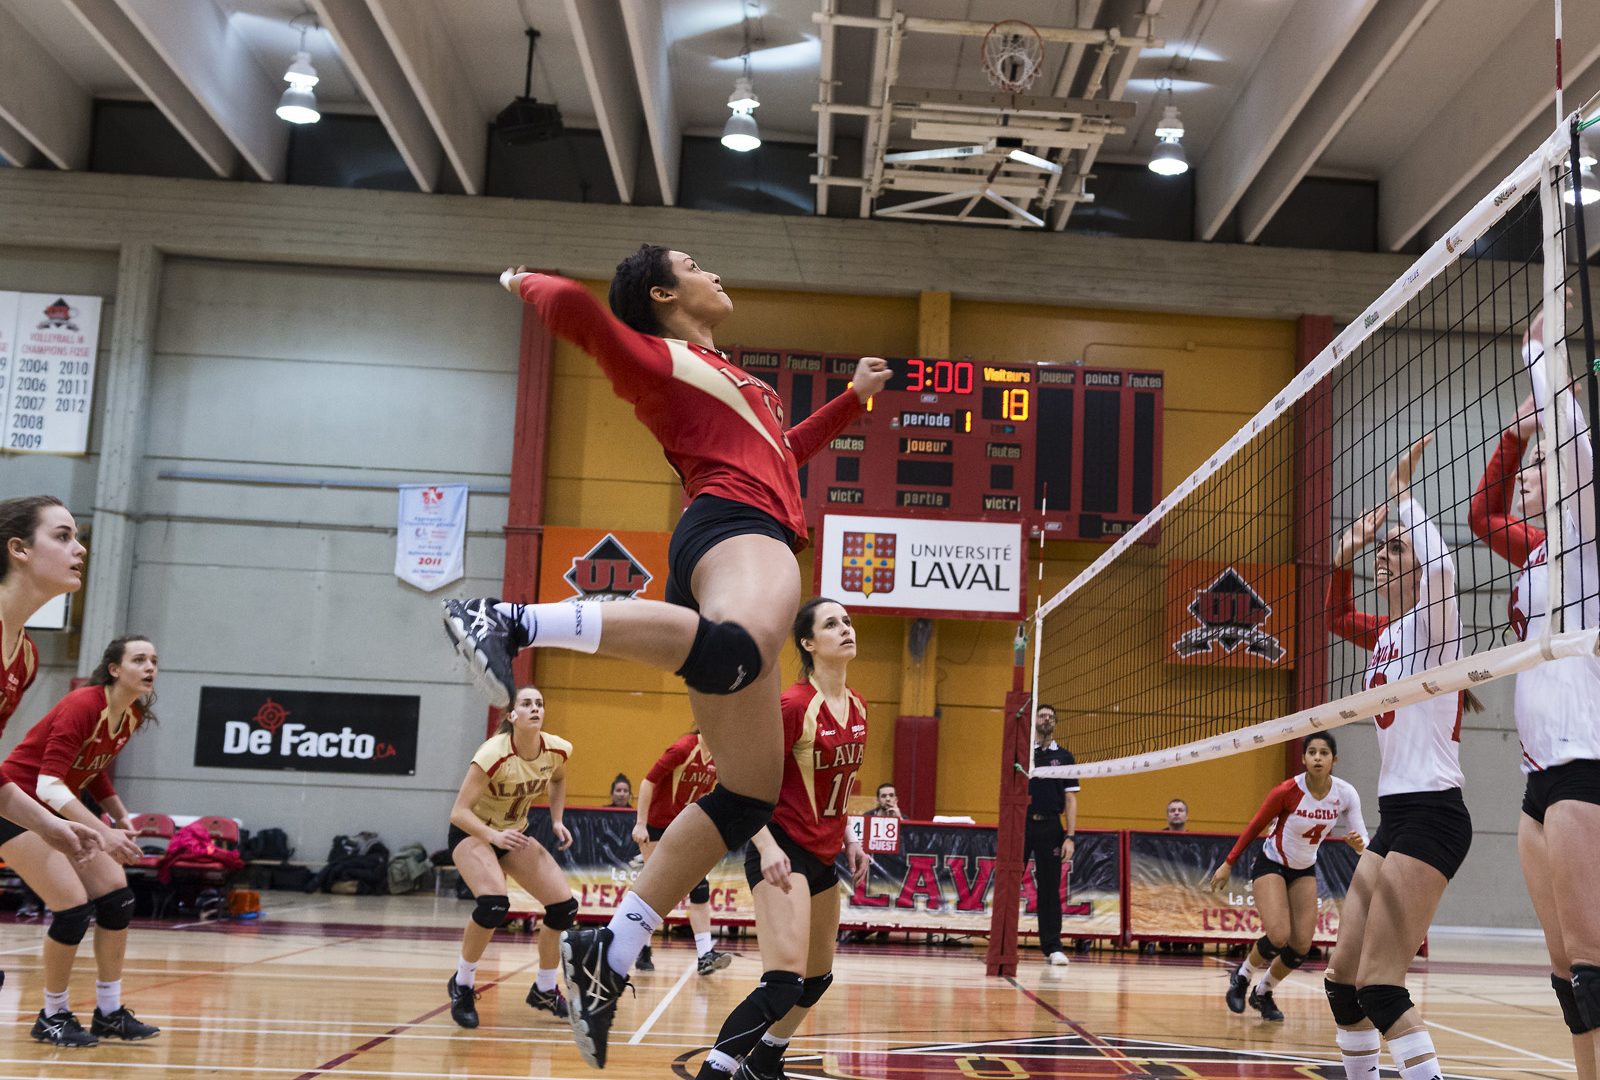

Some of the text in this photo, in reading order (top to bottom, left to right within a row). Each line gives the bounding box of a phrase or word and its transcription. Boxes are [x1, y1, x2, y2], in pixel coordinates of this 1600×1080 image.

[21, 344, 68, 356] CHAMPIONS
[19, 358, 48, 373] 2004
[59, 361, 89, 376] 2010
[742, 353, 778, 368] points
[786, 355, 822, 371] fautes
[832, 359, 856, 374] Loc
[906, 359, 974, 394] 3:00
[983, 367, 1031, 383] Visiteurs
[1039, 369, 1075, 384] joueur
[1085, 373, 1121, 386] points
[1127, 374, 1162, 389] fautes
[17, 376, 47, 392] 2006
[57, 379, 88, 395] 2011
[15, 395, 85, 413] 2007 2012
[1002, 388, 1029, 422] 18
[13, 413, 44, 430] 2008
[903, 412, 951, 427] periode
[965, 410, 972, 433] 1
[11, 432, 42, 449] 2009
[905, 439, 948, 454] joueur
[987, 443, 1021, 459] fautes
[903, 491, 944, 507] partie
[911, 543, 1012, 561] UNIVERSITÉ
[418, 557, 442, 565] 2011
[575, 559, 645, 591] UL
[911, 560, 1010, 592] LAVAL
[1199, 591, 1266, 624] UL
[223, 720, 272, 755] De
[873, 822, 896, 839] 18
[1302, 823, 1328, 845] 4
[869, 840, 897, 851] GUEST
[611, 867, 627, 881] La
[1228, 892, 1243, 905] La
